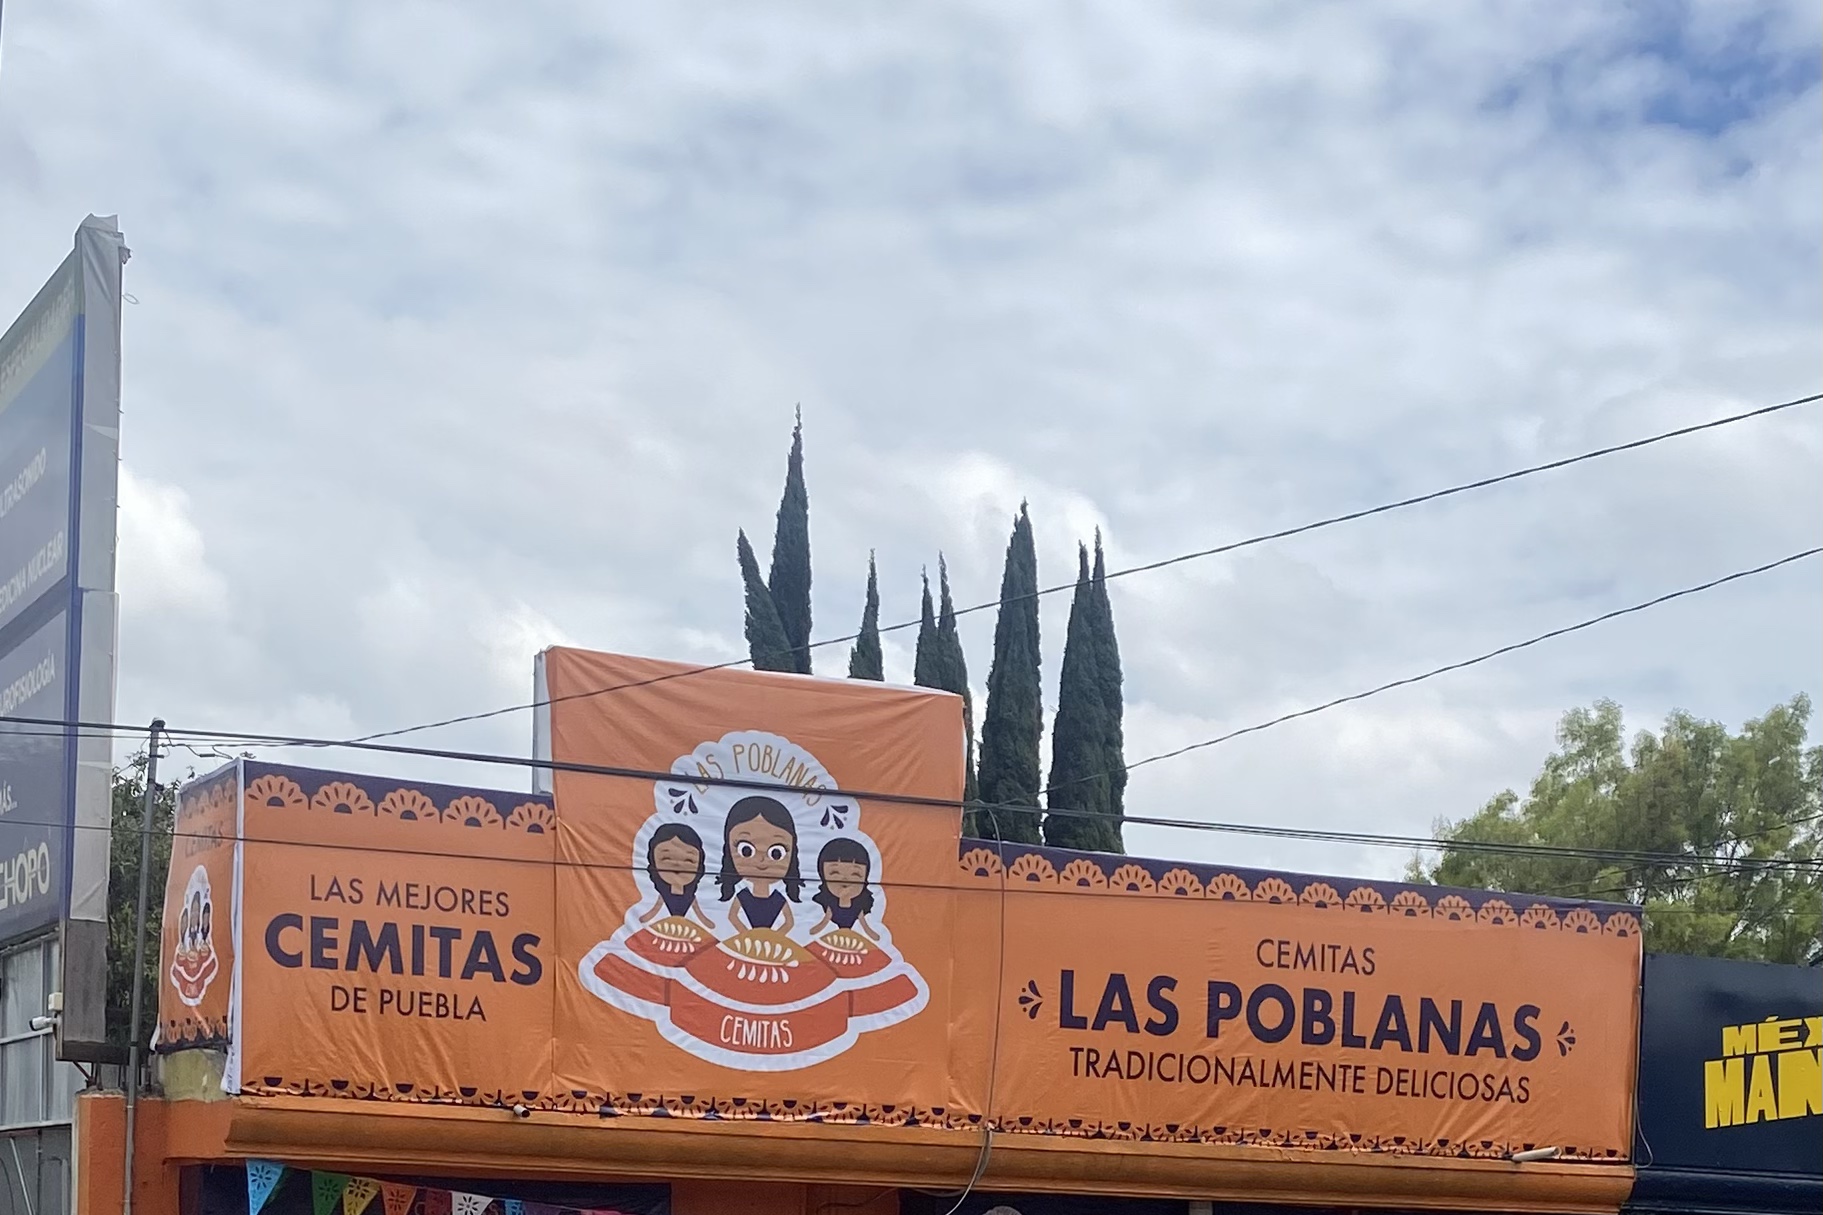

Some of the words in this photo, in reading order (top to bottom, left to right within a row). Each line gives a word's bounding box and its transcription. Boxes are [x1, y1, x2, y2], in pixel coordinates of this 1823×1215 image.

[685, 754, 725, 795] LAS
[732, 742, 827, 806] POBLANAS
[310, 874, 364, 905] LAS
[376, 880, 510, 917] MEJORES
[264, 912, 543, 986] CEMITAS
[1256, 938, 1375, 976] CEMITAS
[331, 985, 367, 1014] DE
[379, 988, 487, 1022] PUEBLA
[720, 1013, 793, 1048] CEMITAS
[1059, 969, 1180, 1037] LAS
[1206, 980, 1542, 1062] POBLANAS
[1069, 1046, 1366, 1094] TRADICIONALMENTE
[1376, 1066, 1530, 1104] DELICIOSAS
[1704, 1047, 1823, 1129] MAN
